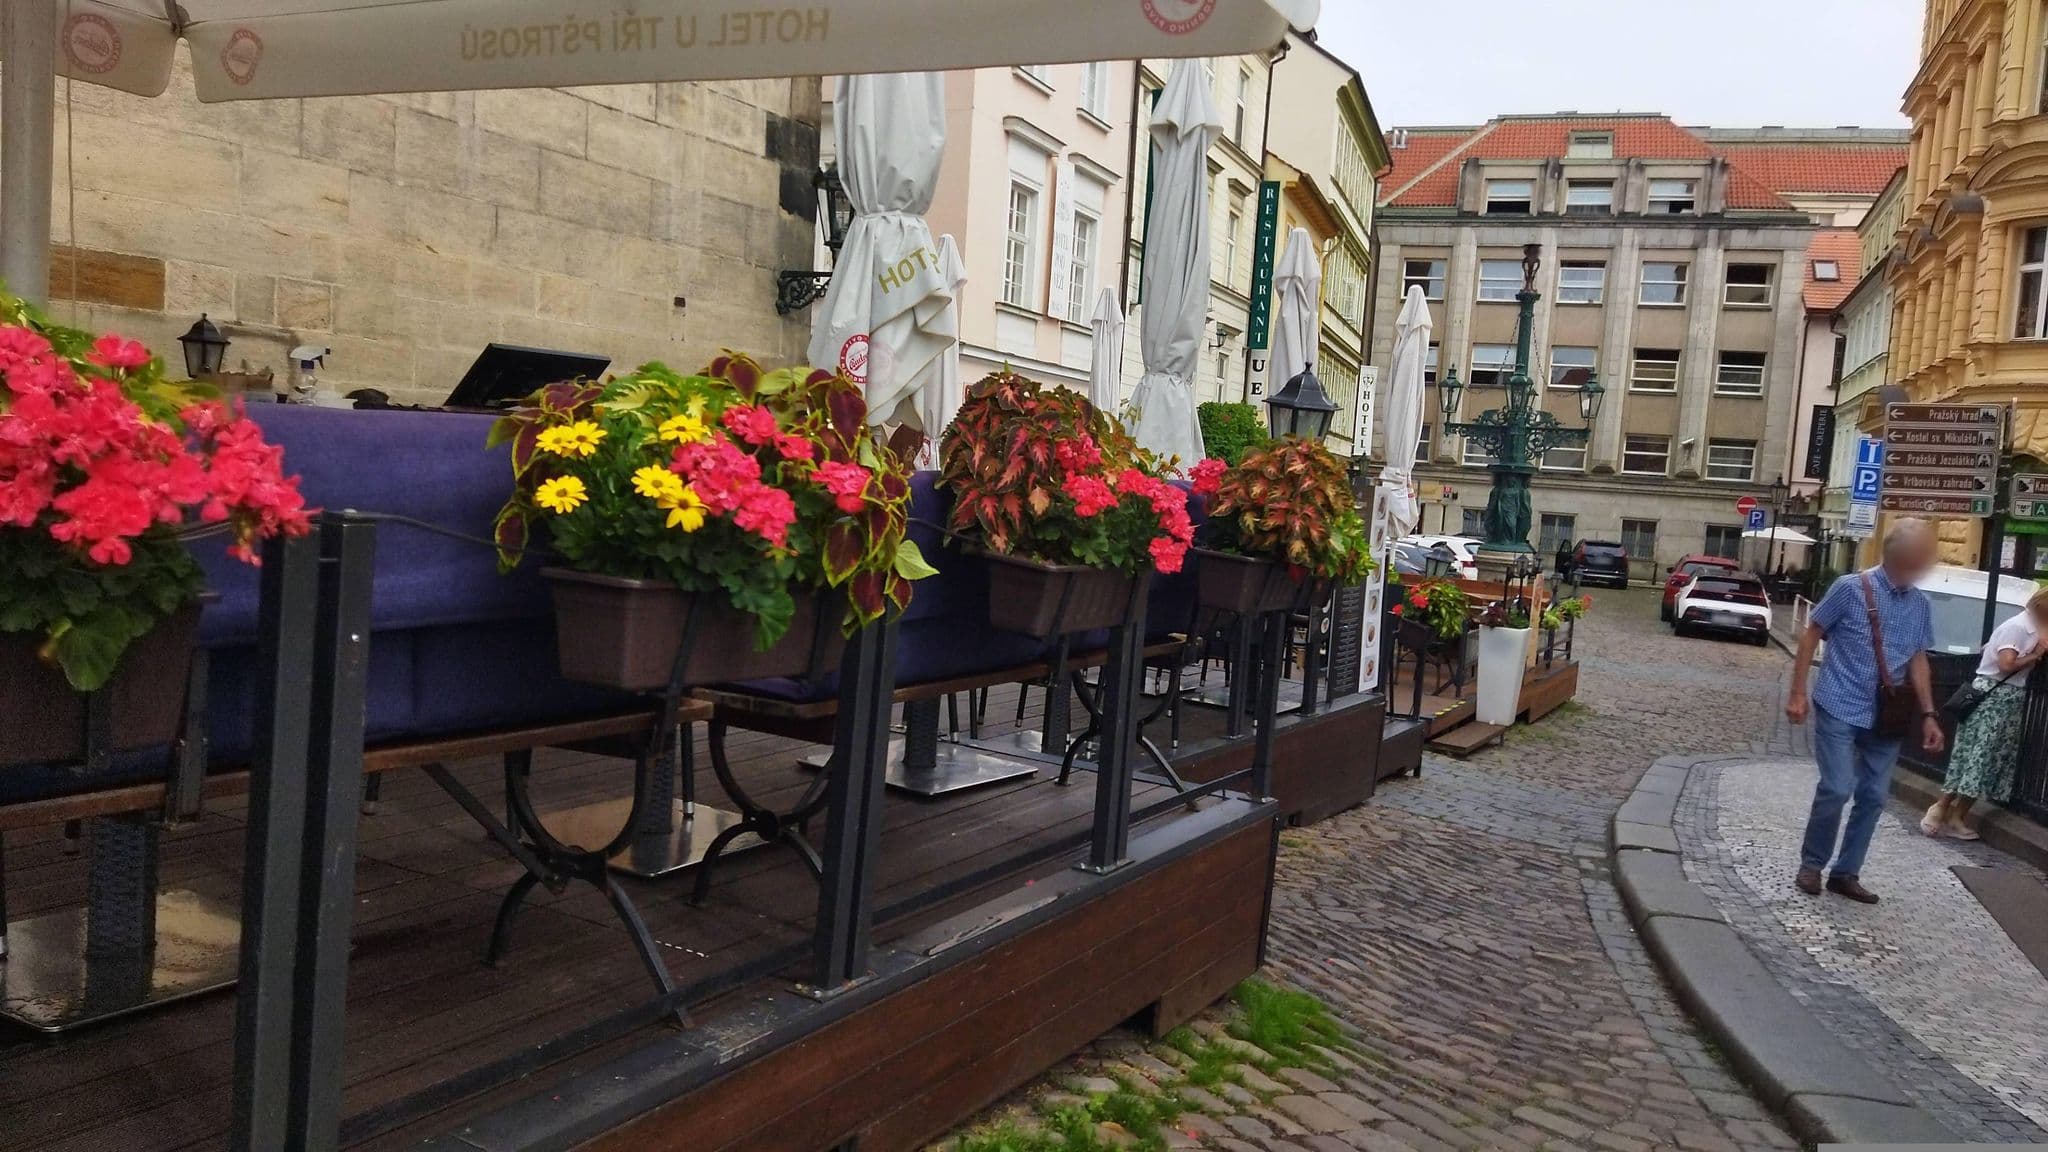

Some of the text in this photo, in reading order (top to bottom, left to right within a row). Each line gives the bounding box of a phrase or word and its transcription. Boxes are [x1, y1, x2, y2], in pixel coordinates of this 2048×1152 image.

[1254, 187, 1275, 343] RESTAURANT
[1360, 390, 1371, 449] HOTEL
[1929, 408, 1979, 423] Pražský hrad
[1906, 431, 1929, 442] Kostel
[1944, 431, 1977, 444] Mikuláše
[1907, 453, 1975, 466] Pražské Jezulátko
[1903, 474, 1973, 488] Vrtbovská zahrada
[2035, 503, 2047, 515] A
